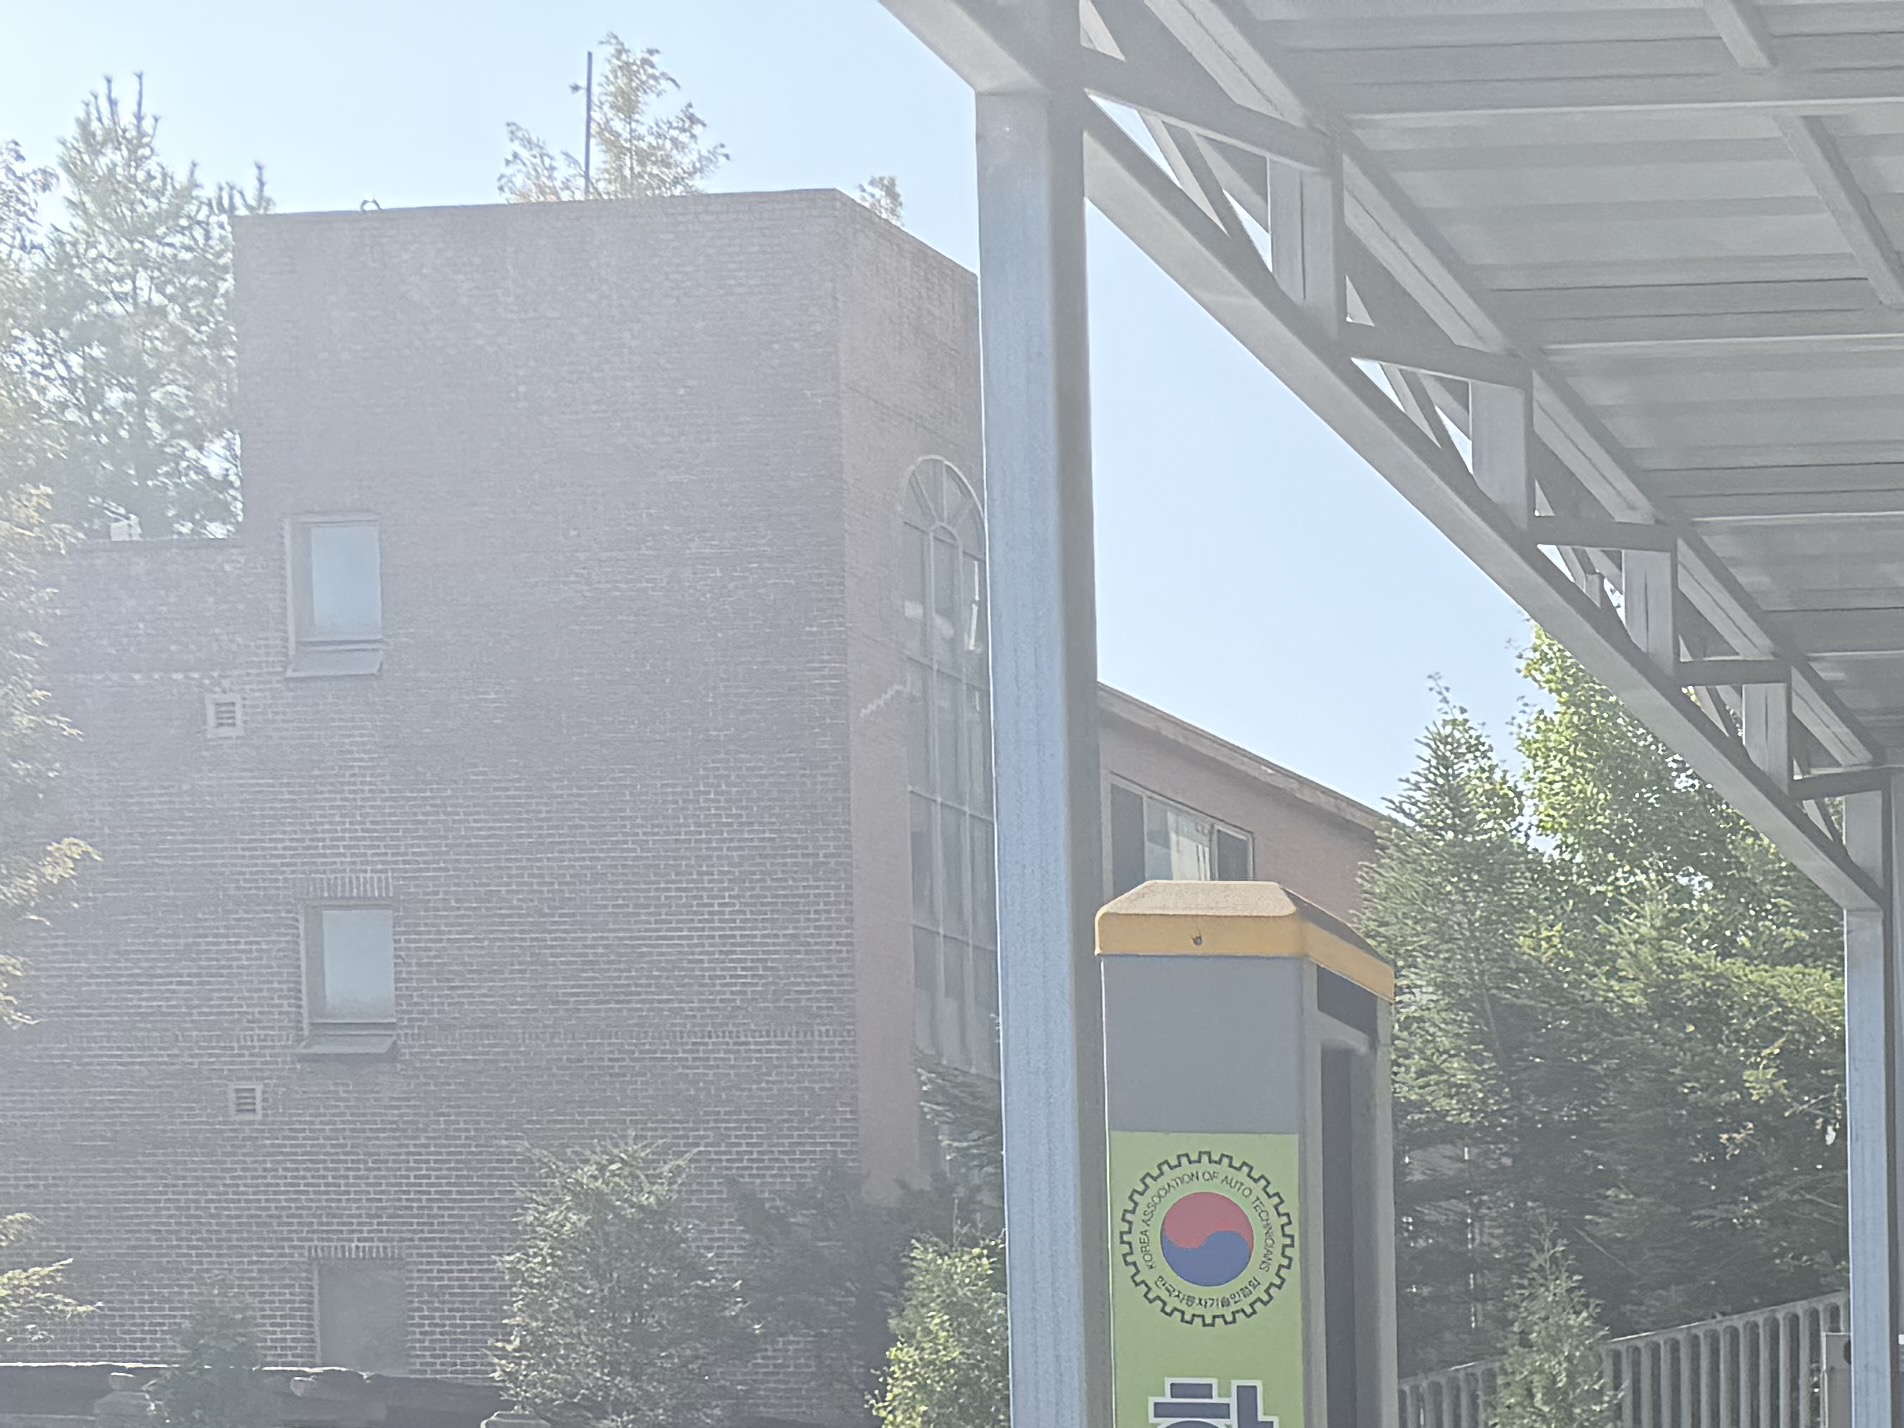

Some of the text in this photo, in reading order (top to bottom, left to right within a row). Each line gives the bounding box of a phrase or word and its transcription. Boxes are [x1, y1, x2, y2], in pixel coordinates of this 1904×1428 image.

[1139, 1171, 1275, 1272] KOREA ASSOCIATION OF AUTO TECHNICIANS
